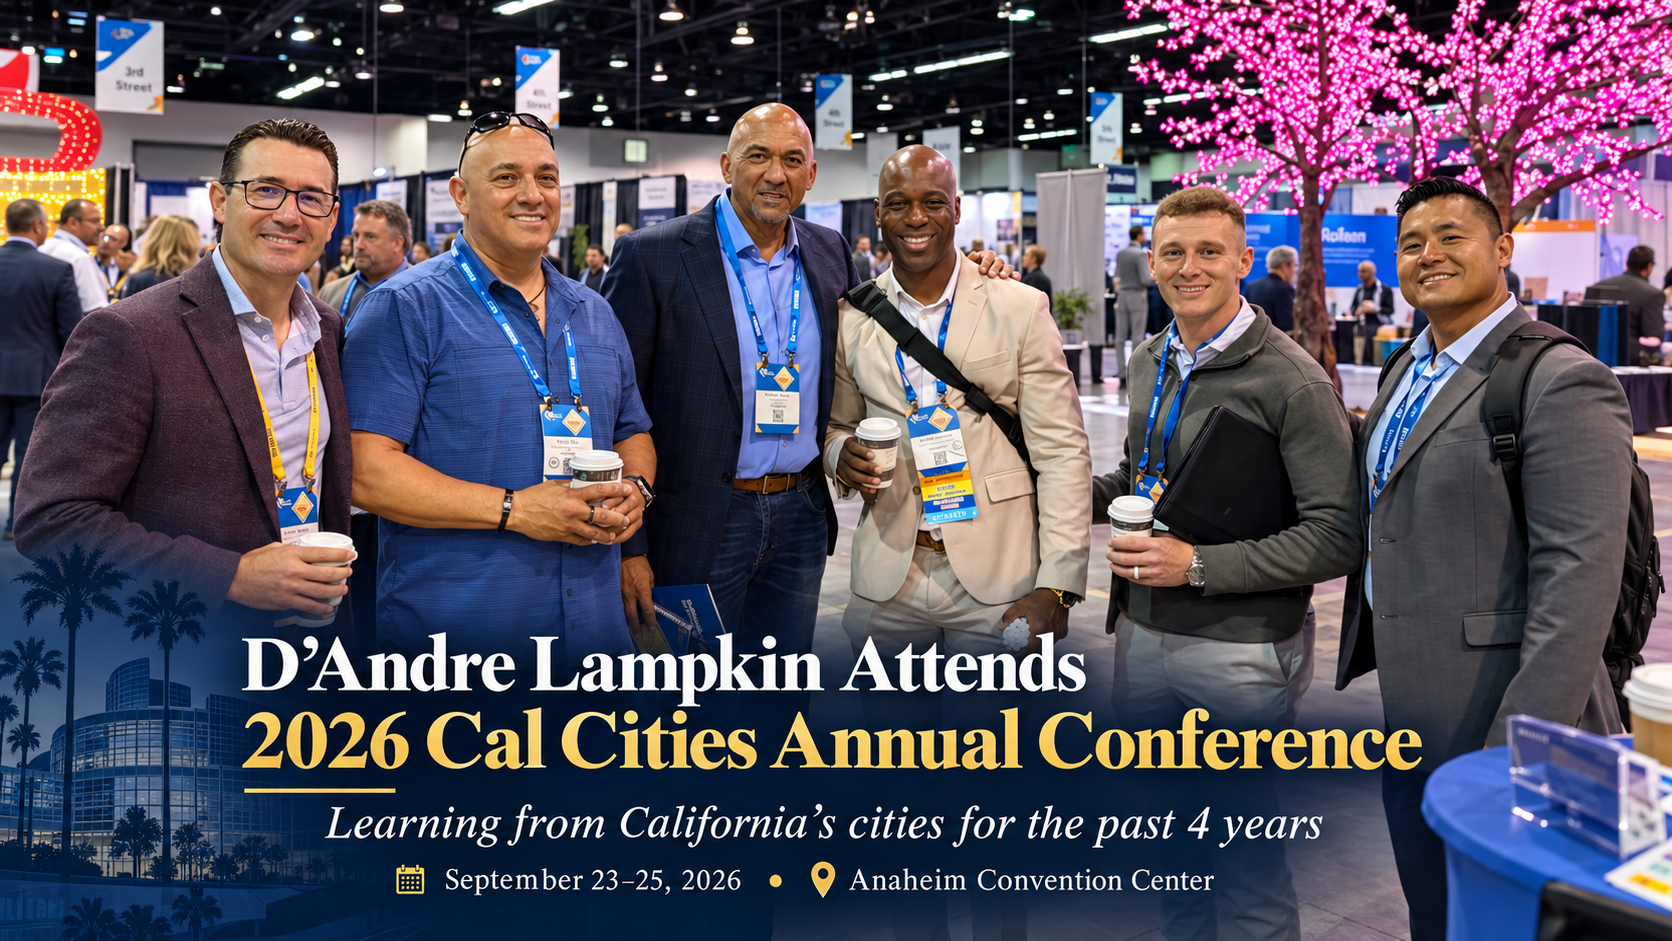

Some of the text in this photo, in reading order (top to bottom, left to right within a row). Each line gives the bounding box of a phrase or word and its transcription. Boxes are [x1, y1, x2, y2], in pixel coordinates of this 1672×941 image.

[125, 66, 144, 77] 3rd
[115, 80, 152, 92] Street
[526, 100, 552, 110] Street
